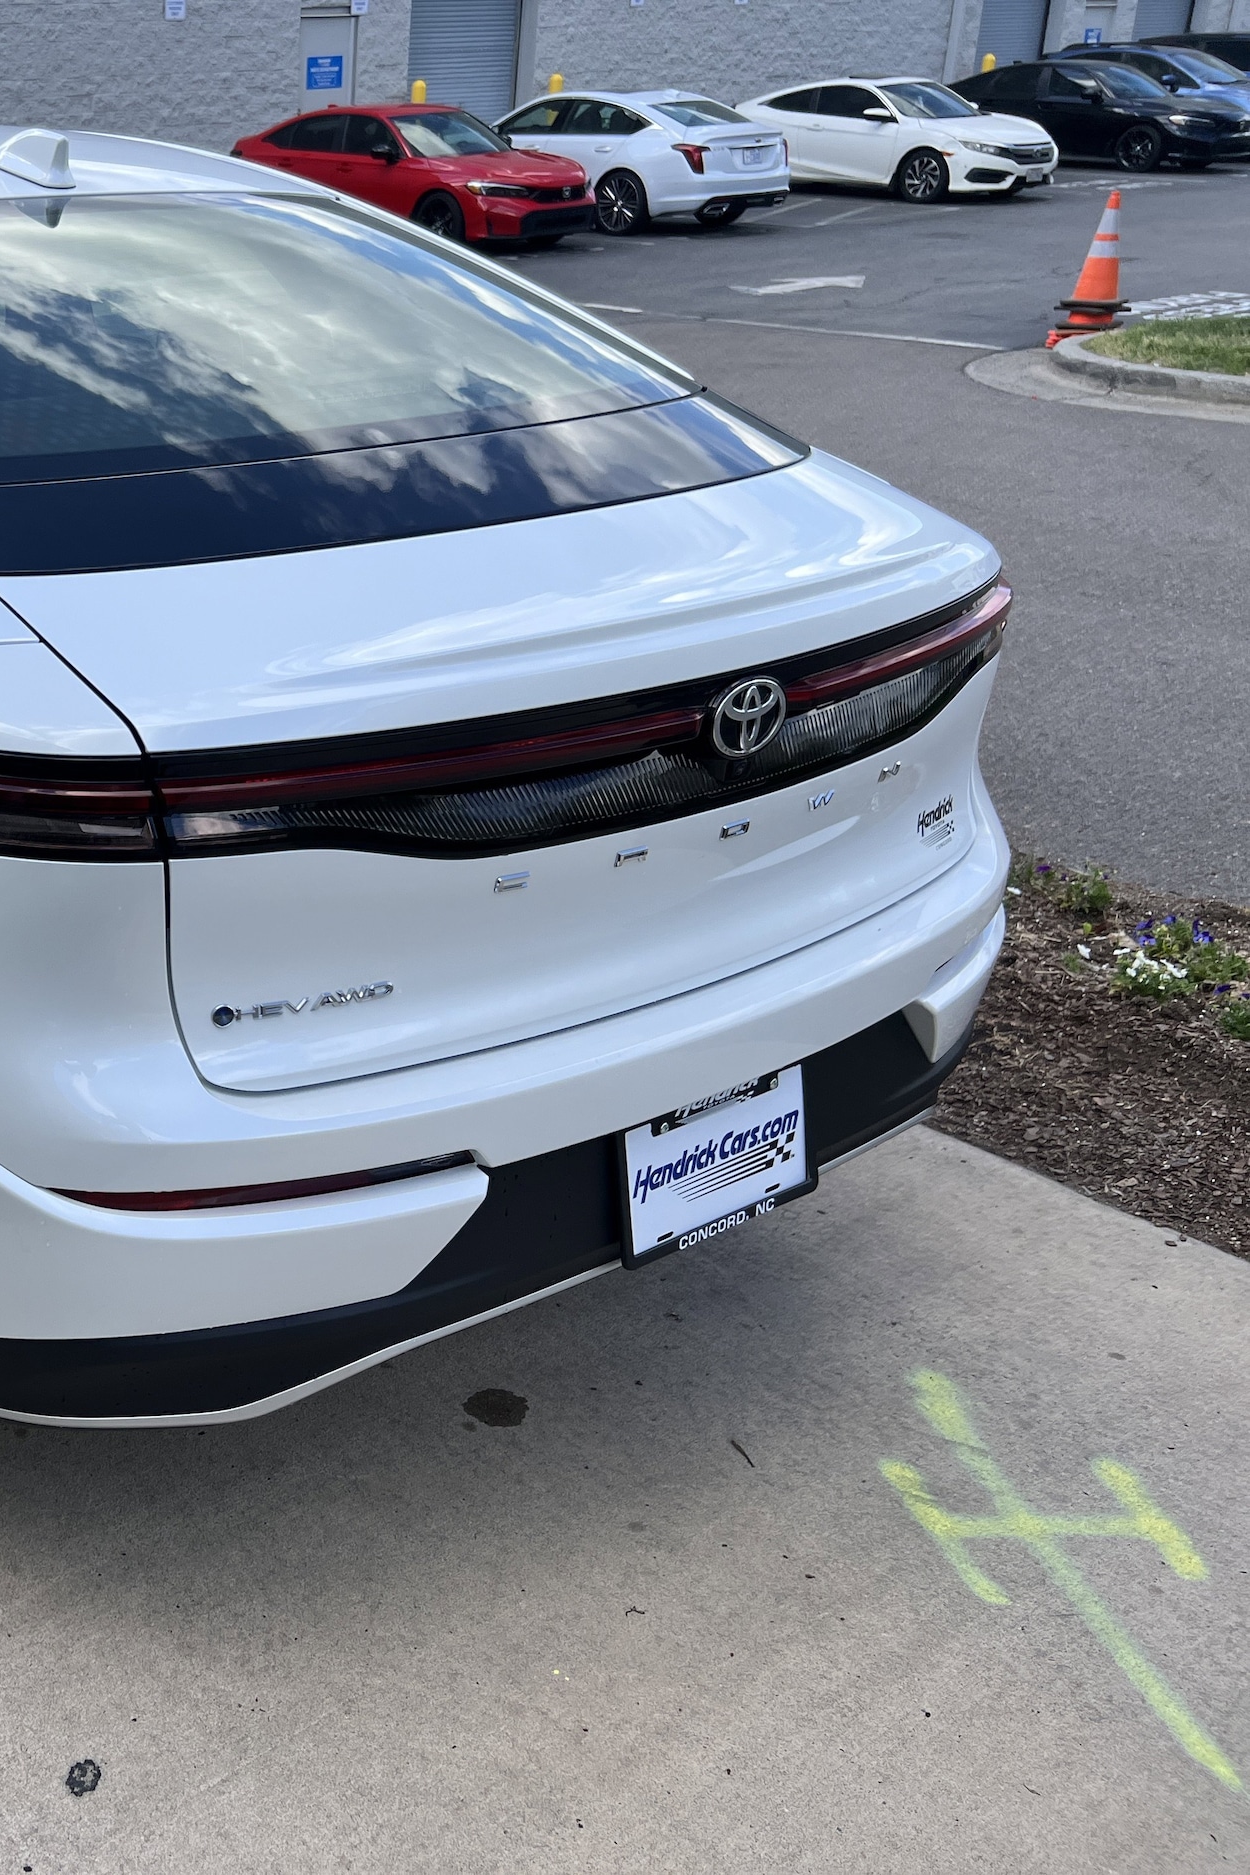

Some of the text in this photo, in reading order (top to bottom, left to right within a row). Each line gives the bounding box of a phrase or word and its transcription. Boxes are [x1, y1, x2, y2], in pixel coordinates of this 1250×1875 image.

[917, 794, 954, 837] Hendrick
[235, 980, 394, 1021] HEV AWD
[755, 1197, 775, 1217] NC
